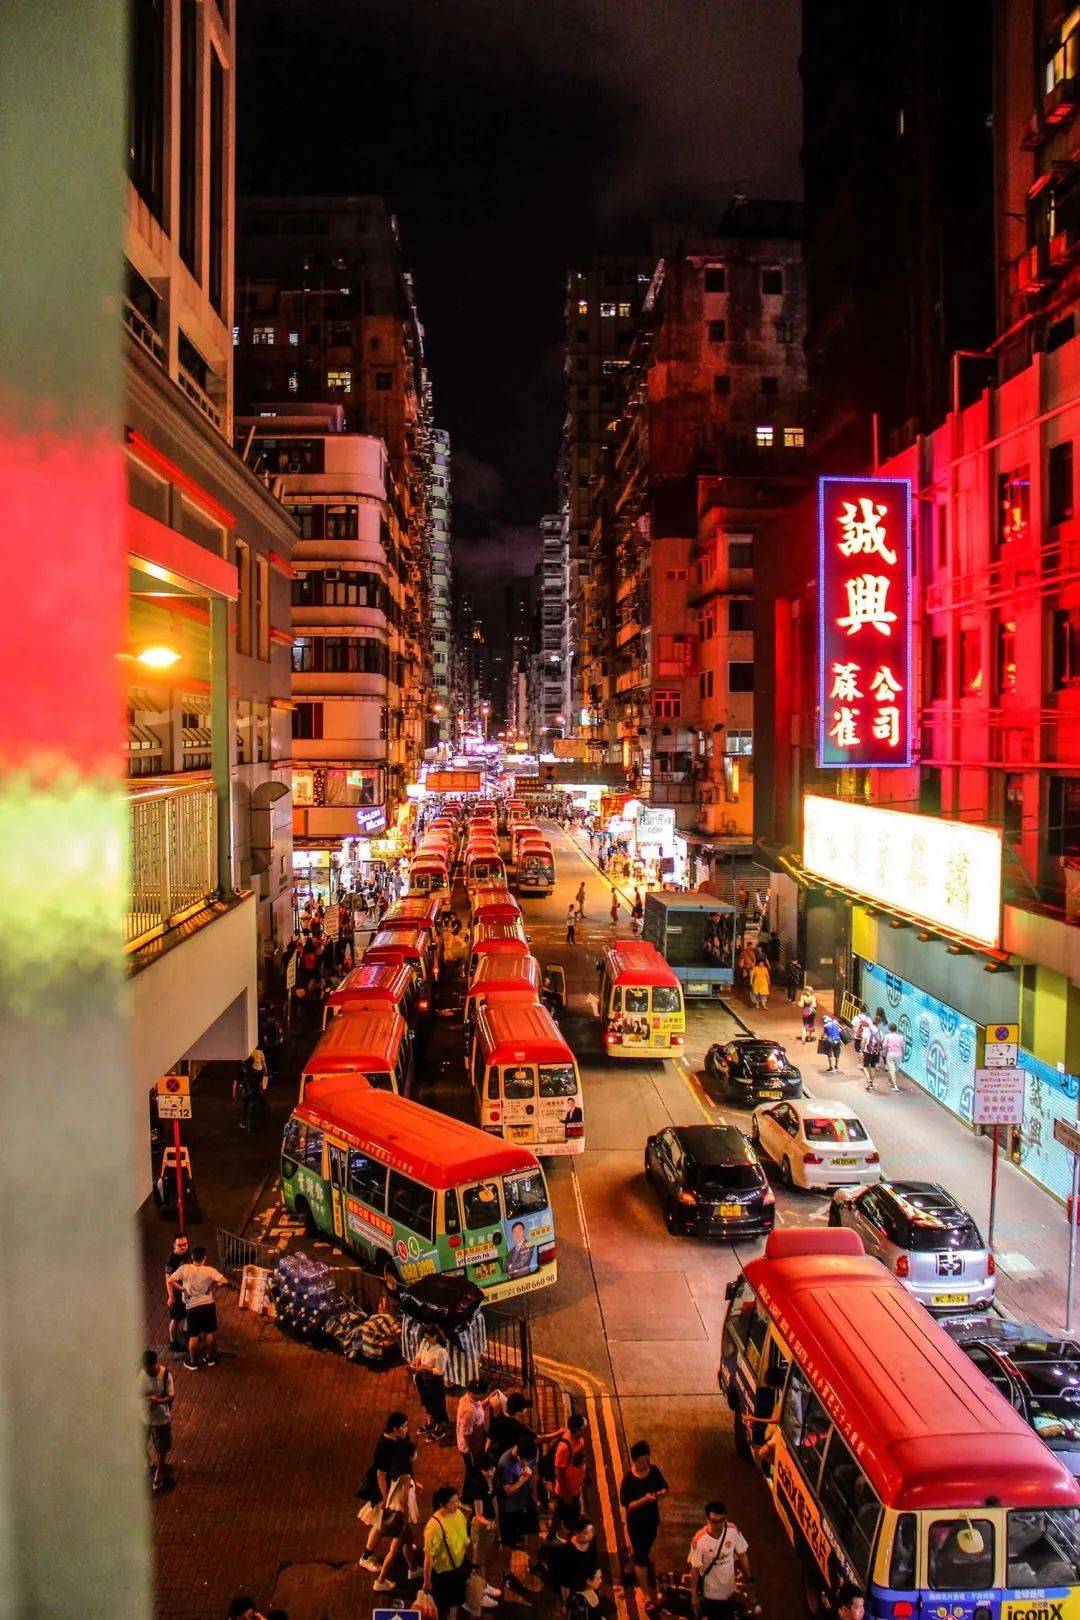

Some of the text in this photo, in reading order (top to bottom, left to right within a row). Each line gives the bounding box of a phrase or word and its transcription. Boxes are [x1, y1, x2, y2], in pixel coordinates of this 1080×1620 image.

[837, 497, 898, 636] 誠興
[869, 665, 903, 747] 公司
[1005, 1044, 1011, 1053] 7
[1005, 1057, 1016, 1066] 12
[179, 1109, 190, 1118] 12
